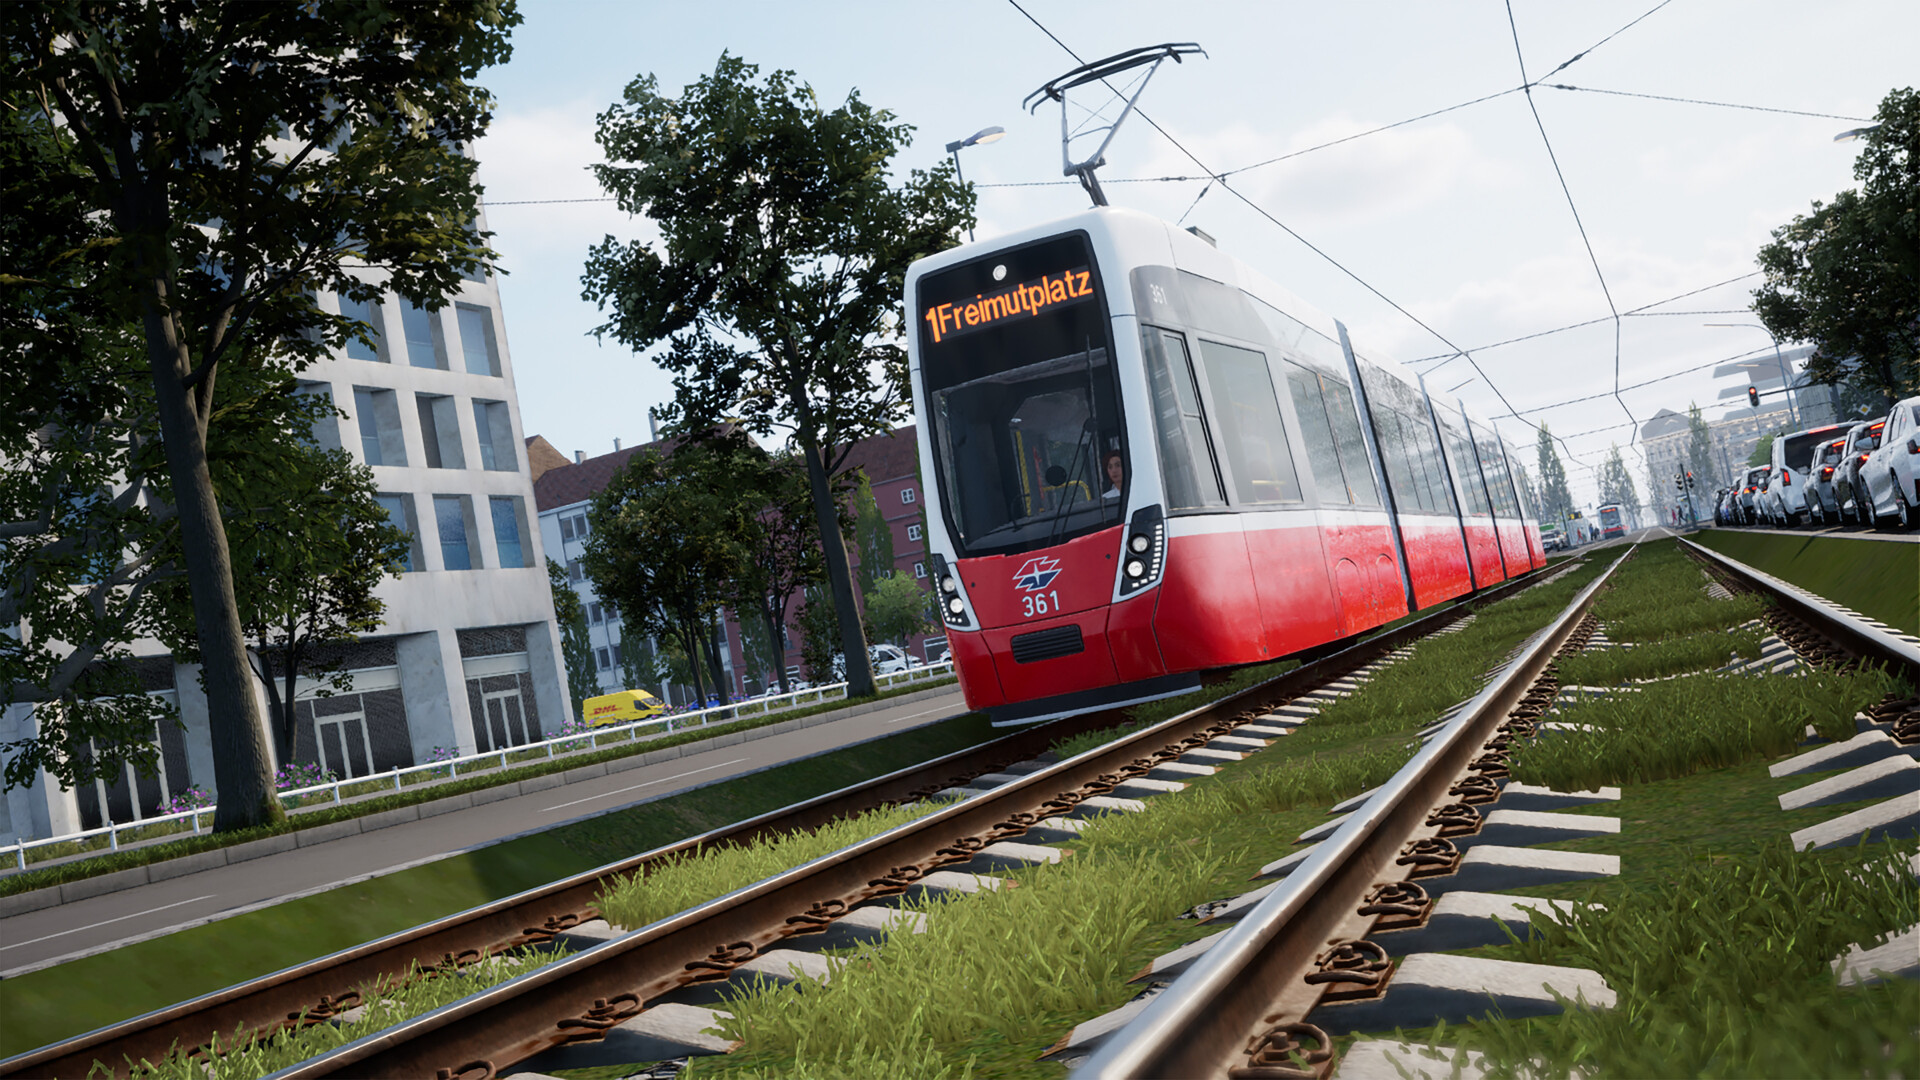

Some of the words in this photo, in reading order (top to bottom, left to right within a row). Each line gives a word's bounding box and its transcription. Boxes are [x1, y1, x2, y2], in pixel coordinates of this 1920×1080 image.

[925, 307, 941, 342] 1
[937, 270, 1093, 334] Freimutplatz
[1150, 283, 1168, 305] 361
[1022, 590, 1060, 617] 361
[592, 704, 617, 715] DHL
